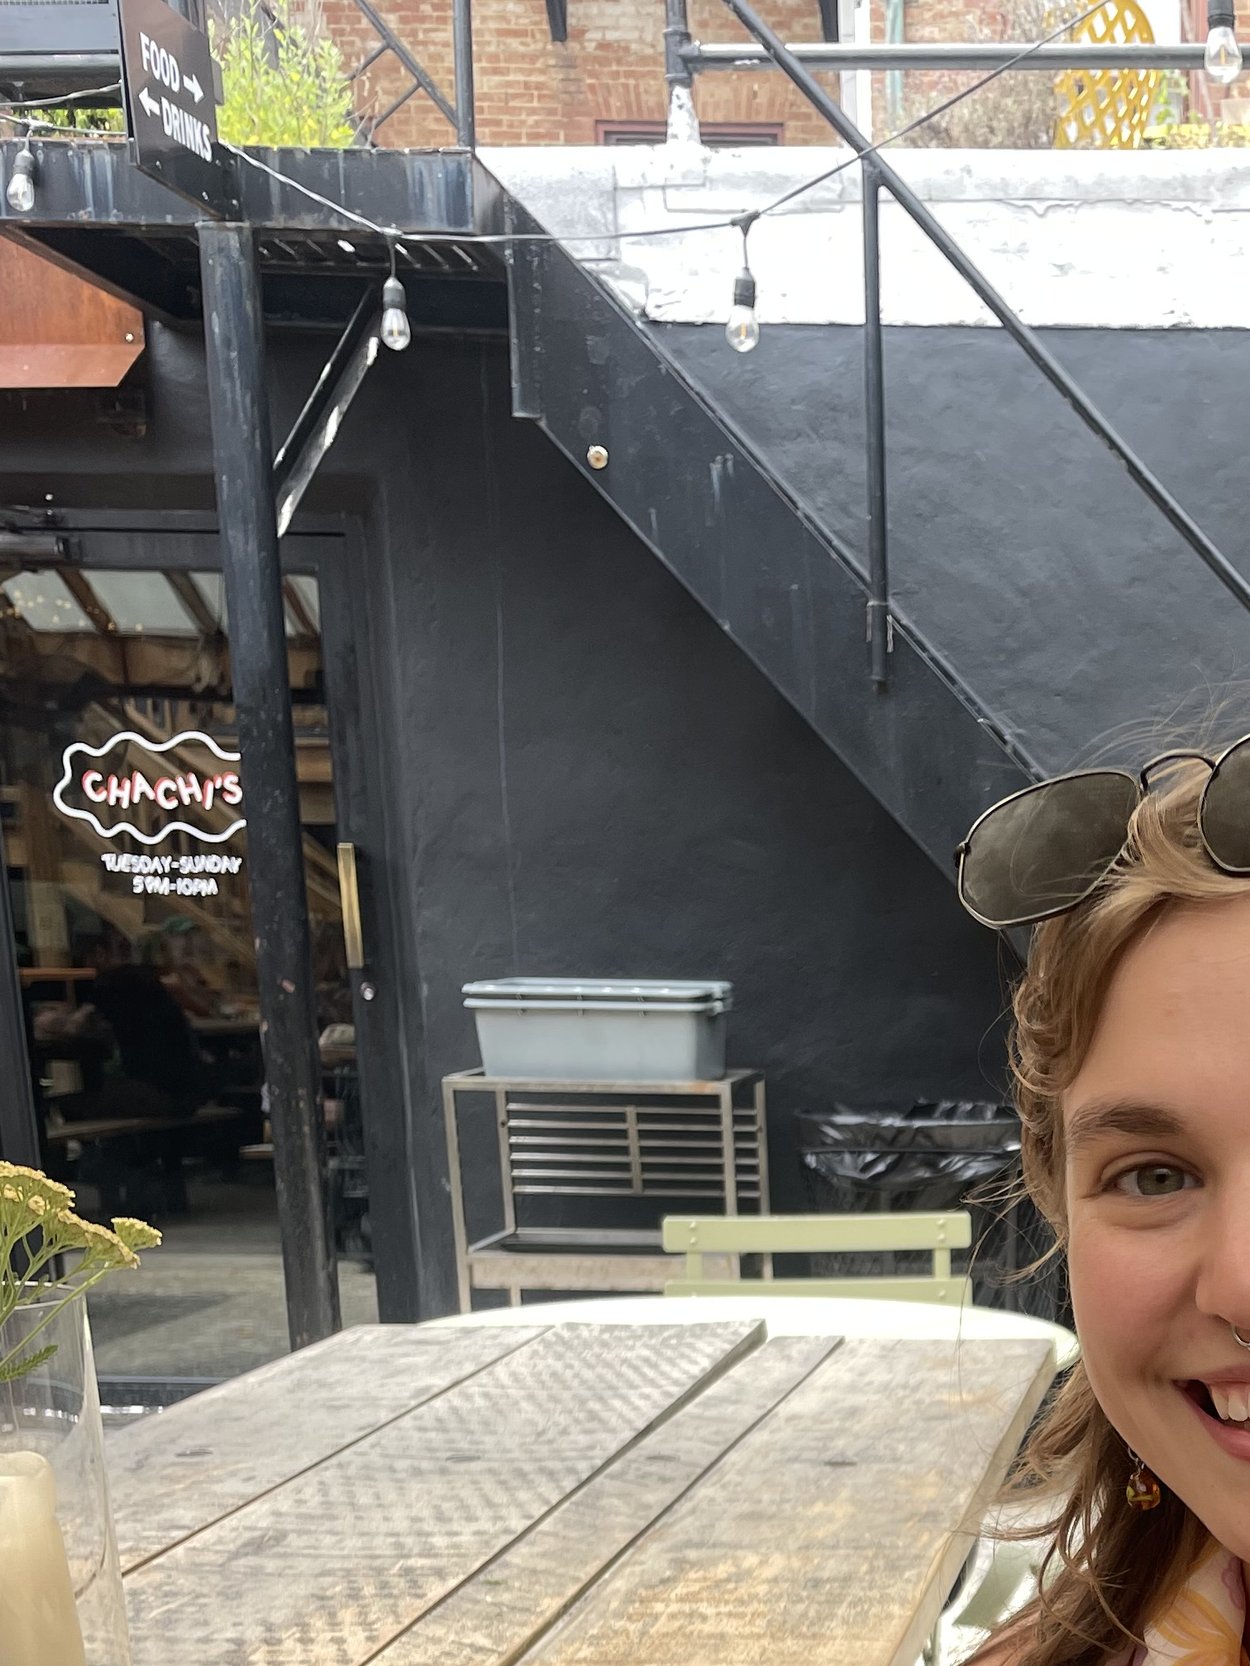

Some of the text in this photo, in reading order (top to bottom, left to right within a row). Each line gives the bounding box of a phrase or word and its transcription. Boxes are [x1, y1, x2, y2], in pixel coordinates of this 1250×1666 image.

[139, 31, 180, 93] FOOD
[160, 96, 213, 163] DRINKS
[82, 770, 243, 809] CHACHI'S
